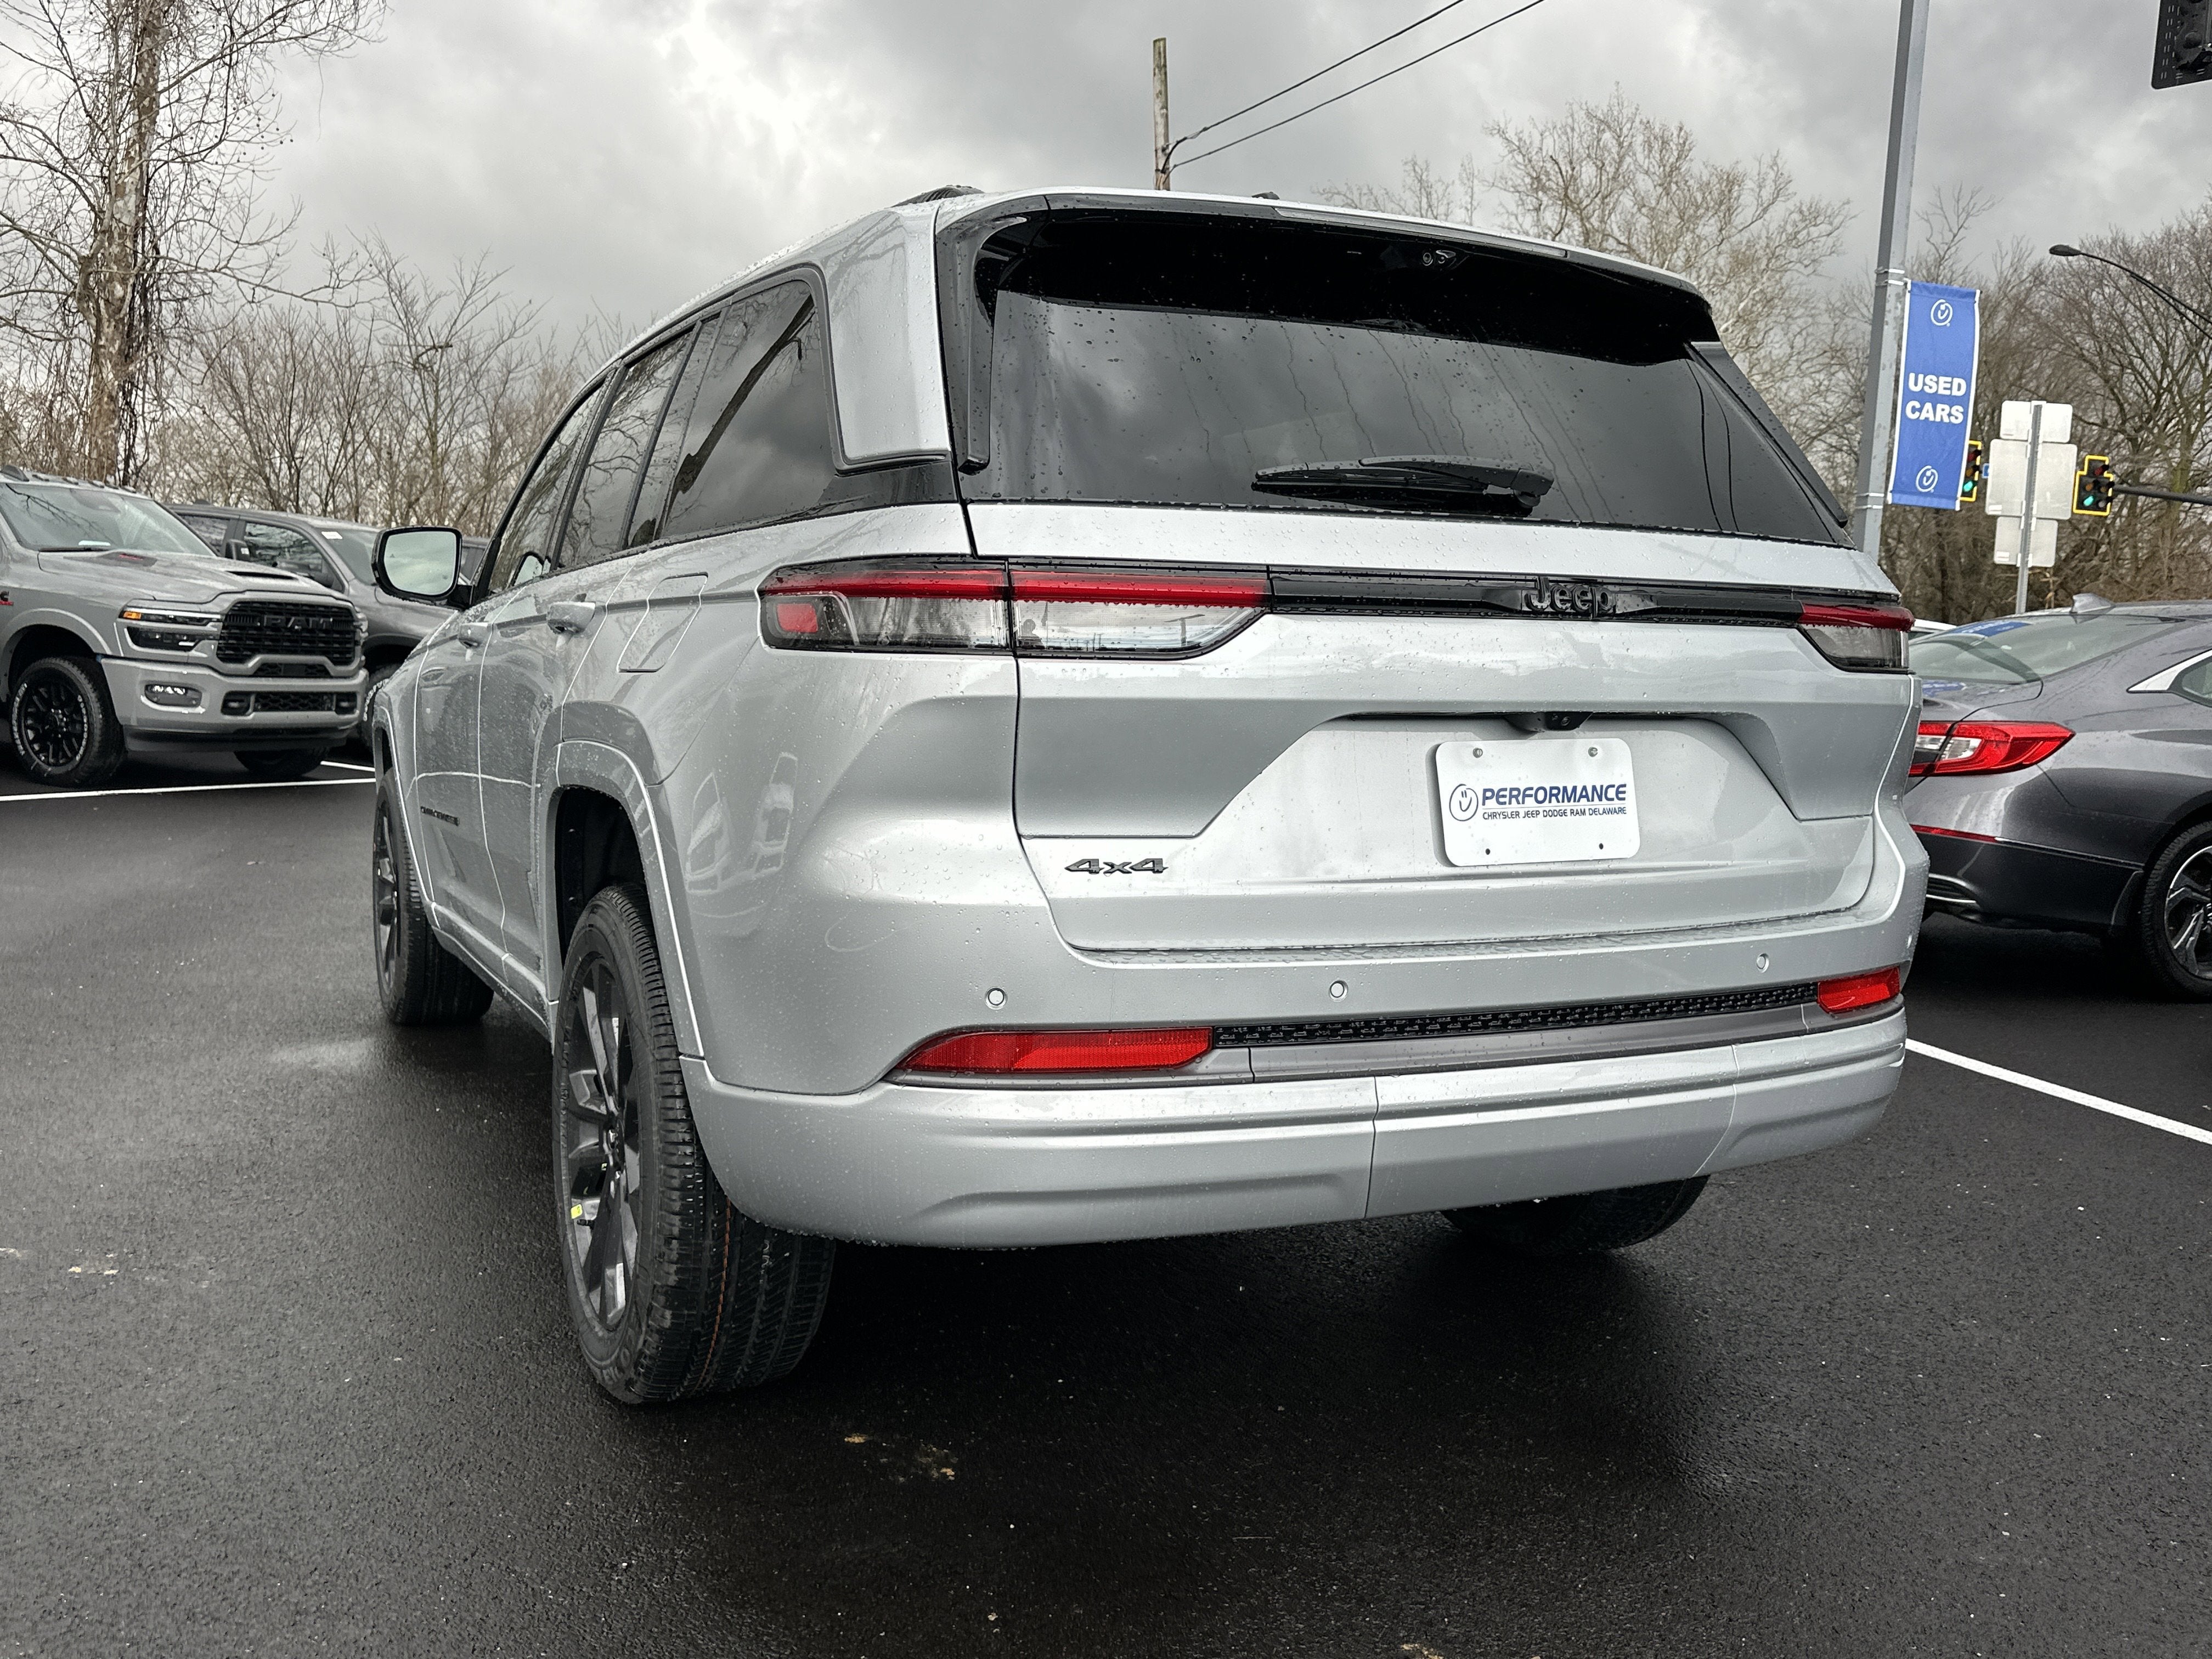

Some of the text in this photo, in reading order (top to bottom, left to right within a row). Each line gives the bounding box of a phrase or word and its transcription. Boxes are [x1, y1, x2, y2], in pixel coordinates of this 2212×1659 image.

[1908, 373, 1967, 397] USED
[1905, 400, 1964, 424] CARS
[1523, 576, 1616, 620] Jeep
[263, 614, 333, 629] RAM
[1481, 783, 1627, 806] PERFORMANCE
[1482, 806, 1627, 820] CHRYSLER JEEP DODGE RAM DELAWARE
[1064, 858, 1169, 874] 4x4
